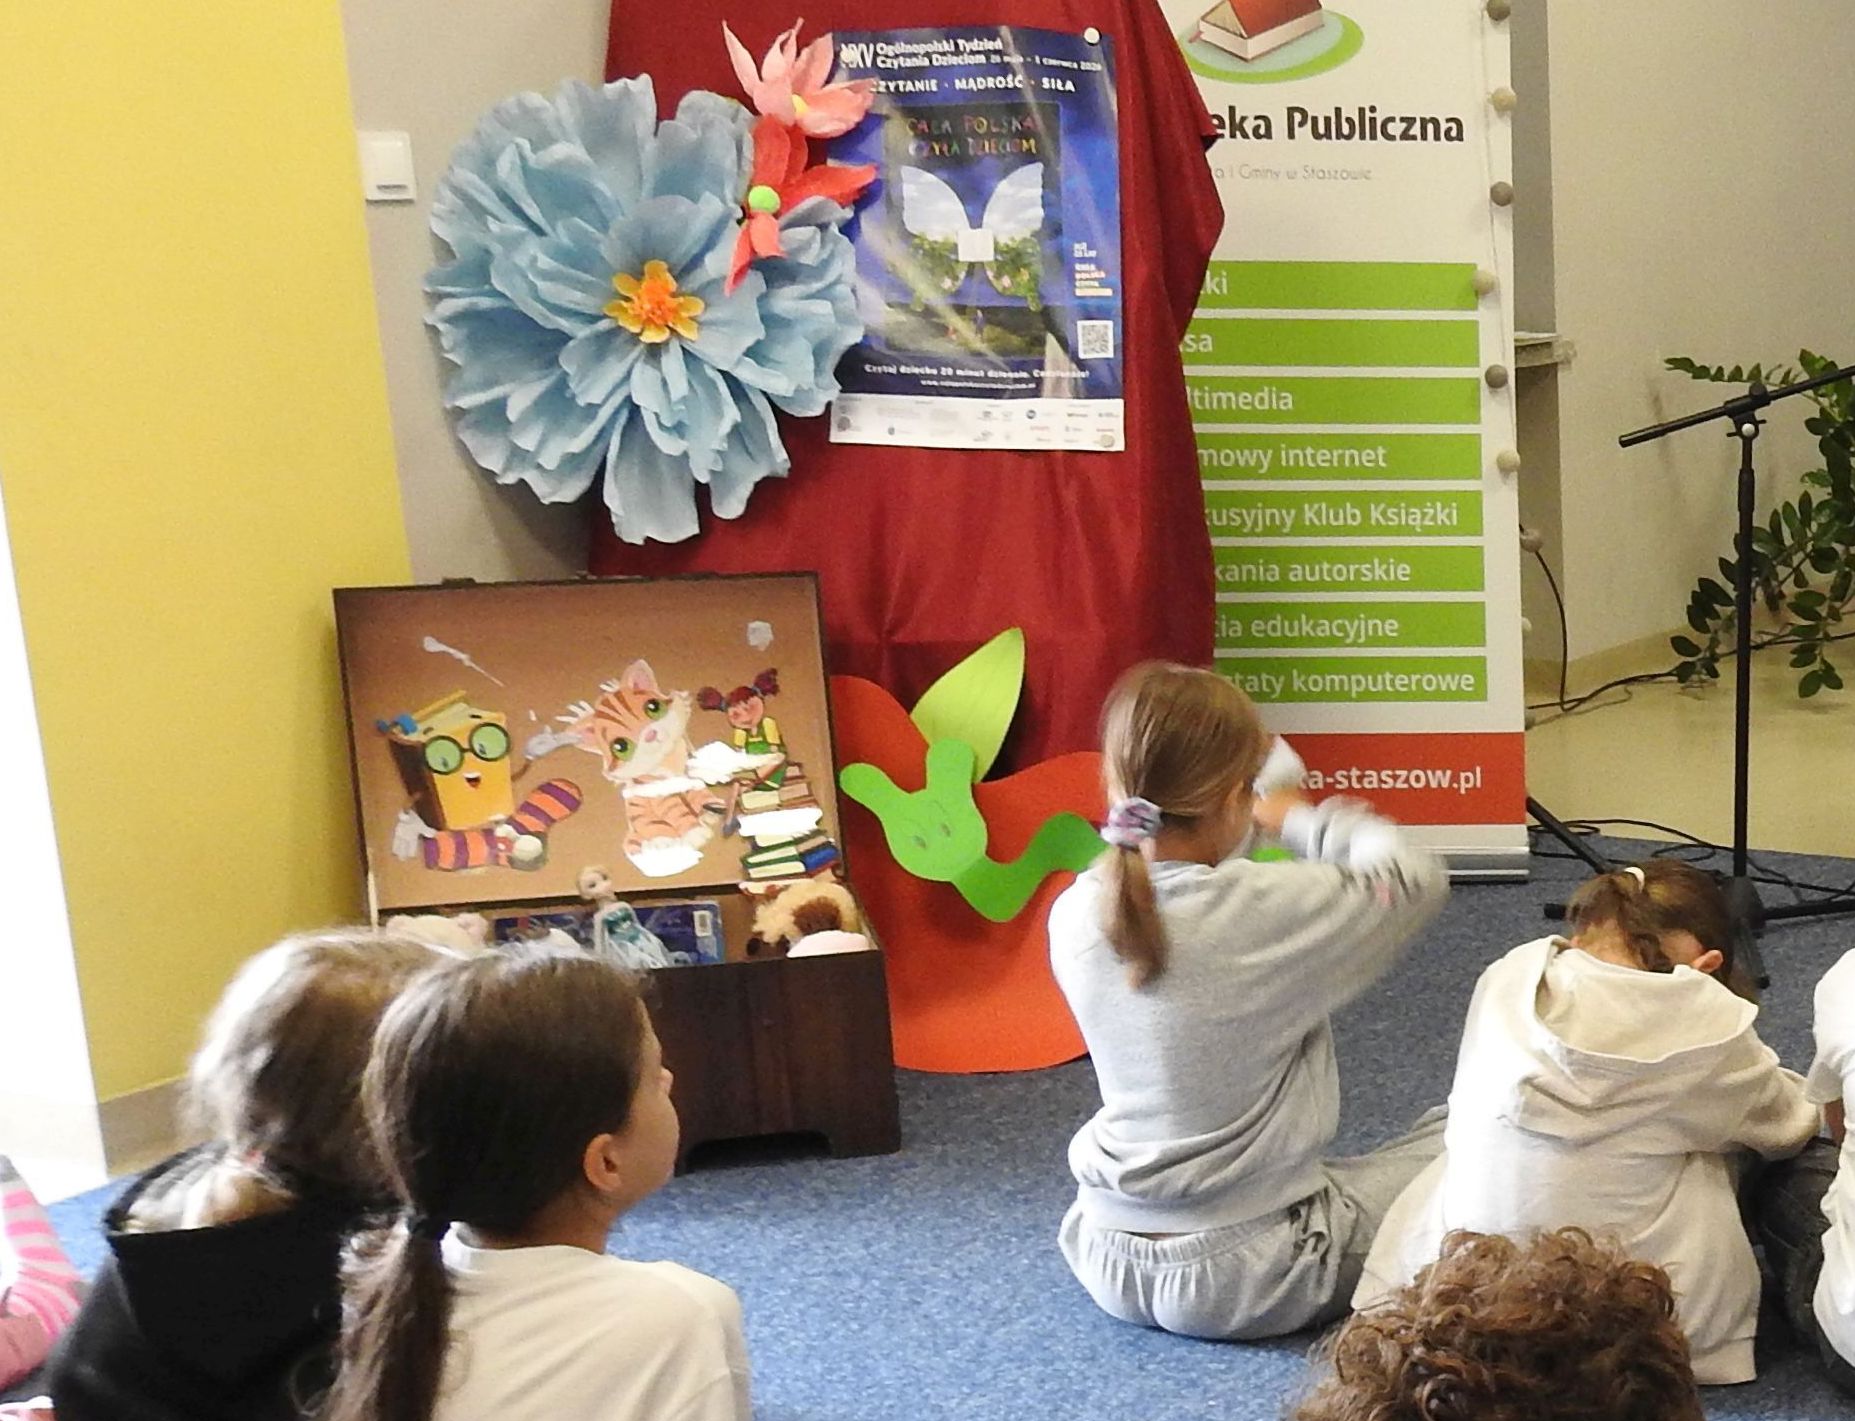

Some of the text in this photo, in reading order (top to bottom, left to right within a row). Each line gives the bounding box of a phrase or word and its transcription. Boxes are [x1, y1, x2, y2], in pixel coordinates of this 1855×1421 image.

[870, 78, 938, 93] ZYTANIE
[1042, 77, 1076, 93] SIŁA
[1286, 105, 1465, 142] Publiczna
[1281, 443, 1387, 468] internet
[1205, 502, 1457, 533] usyjny Klub Książki
[1289, 557, 1411, 583] autorskie
[1251, 613, 1399, 643] edukacyjne
[1225, 668, 1475, 699] taty komputerowe
